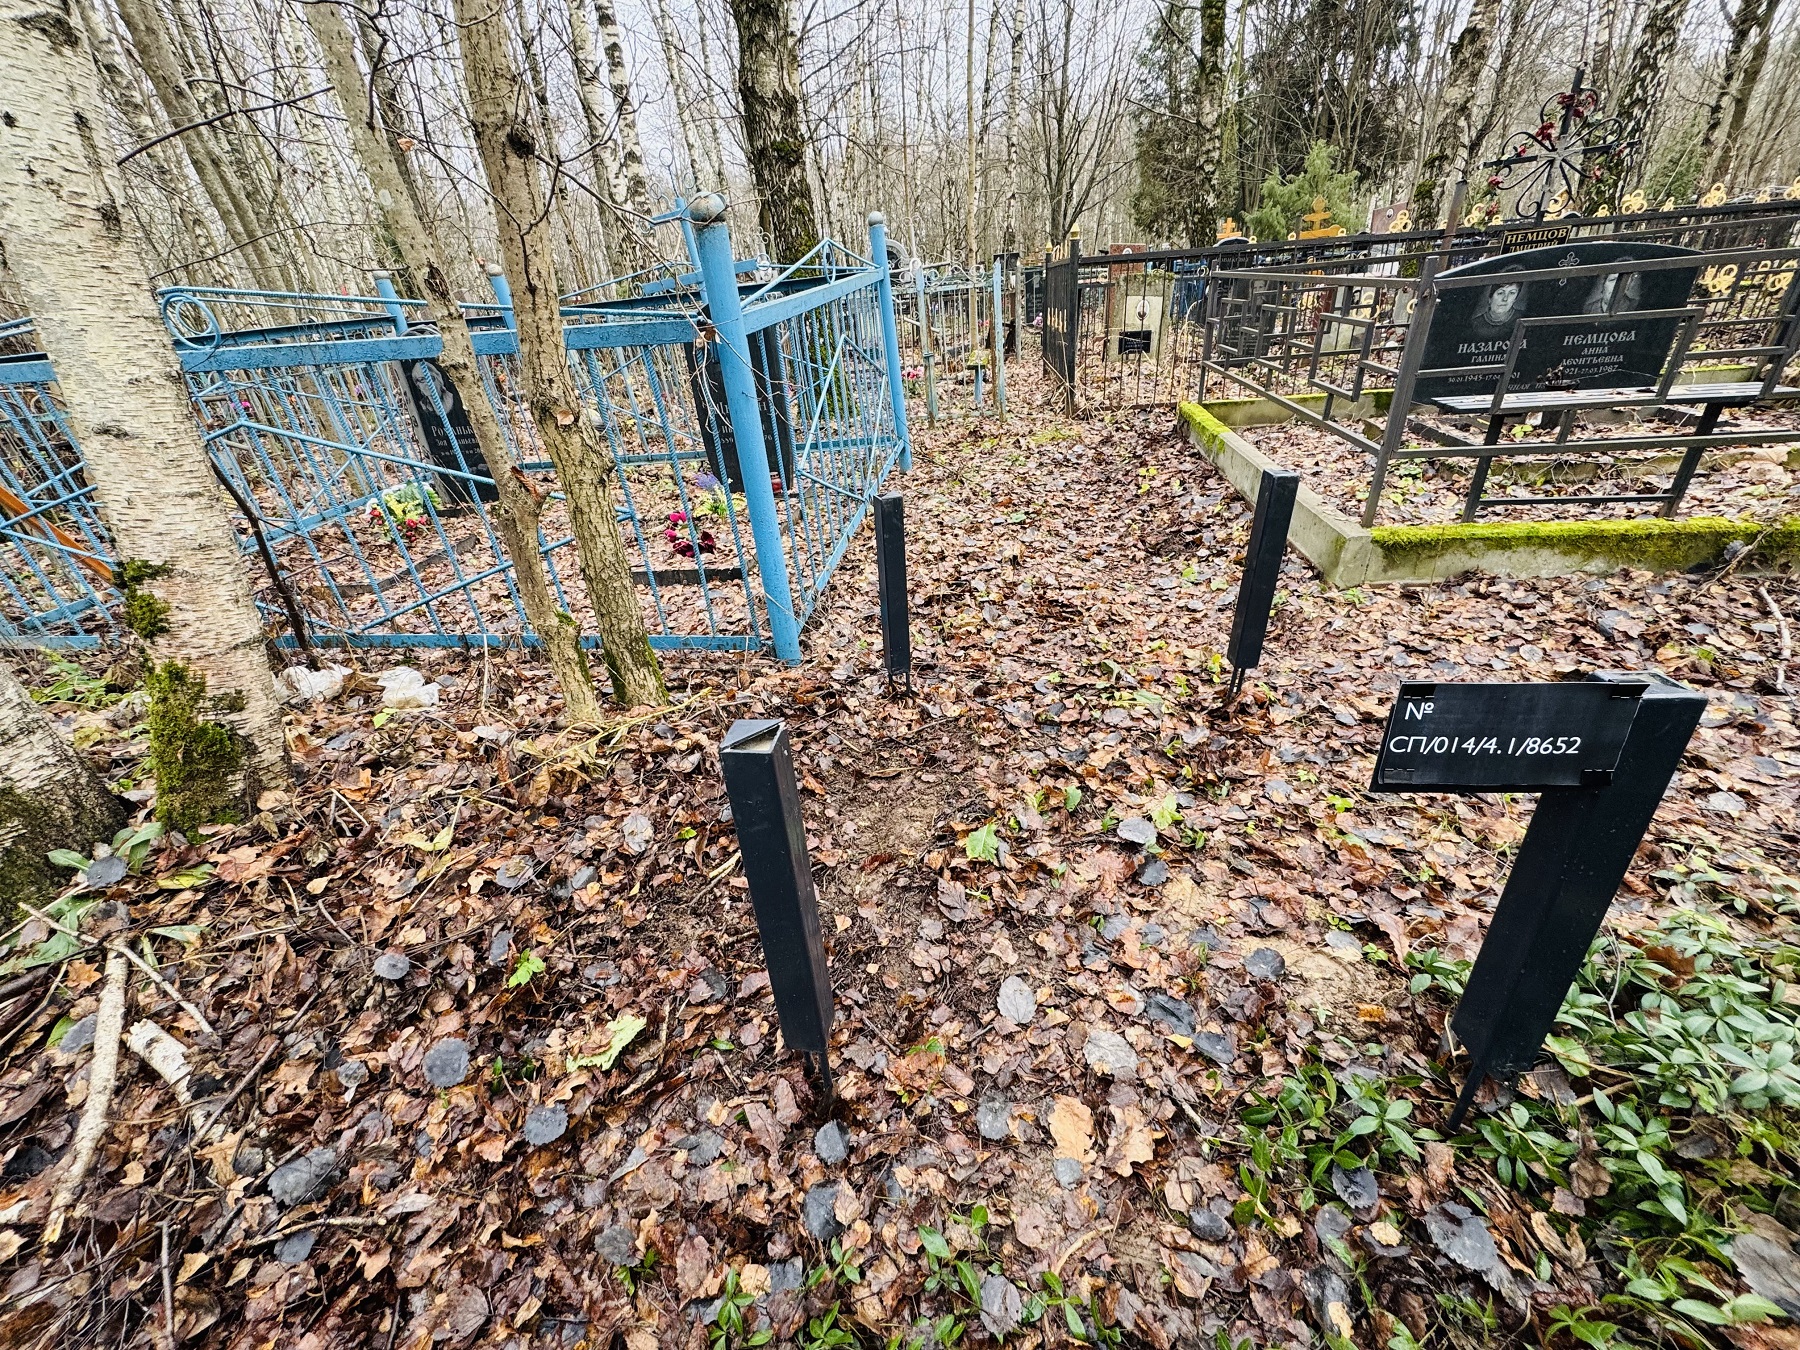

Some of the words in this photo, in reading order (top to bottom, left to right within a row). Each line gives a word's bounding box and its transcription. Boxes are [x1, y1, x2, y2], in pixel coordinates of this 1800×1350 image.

[1506, 228, 1567, 245] НЕМЦОВ
[1562, 330, 1636, 346] НЕМЦОВА
[1457, 339, 1527, 354] НАЗАРОА
[1581, 346, 1609, 355] АННА
[1404, 702, 1435, 720] №
